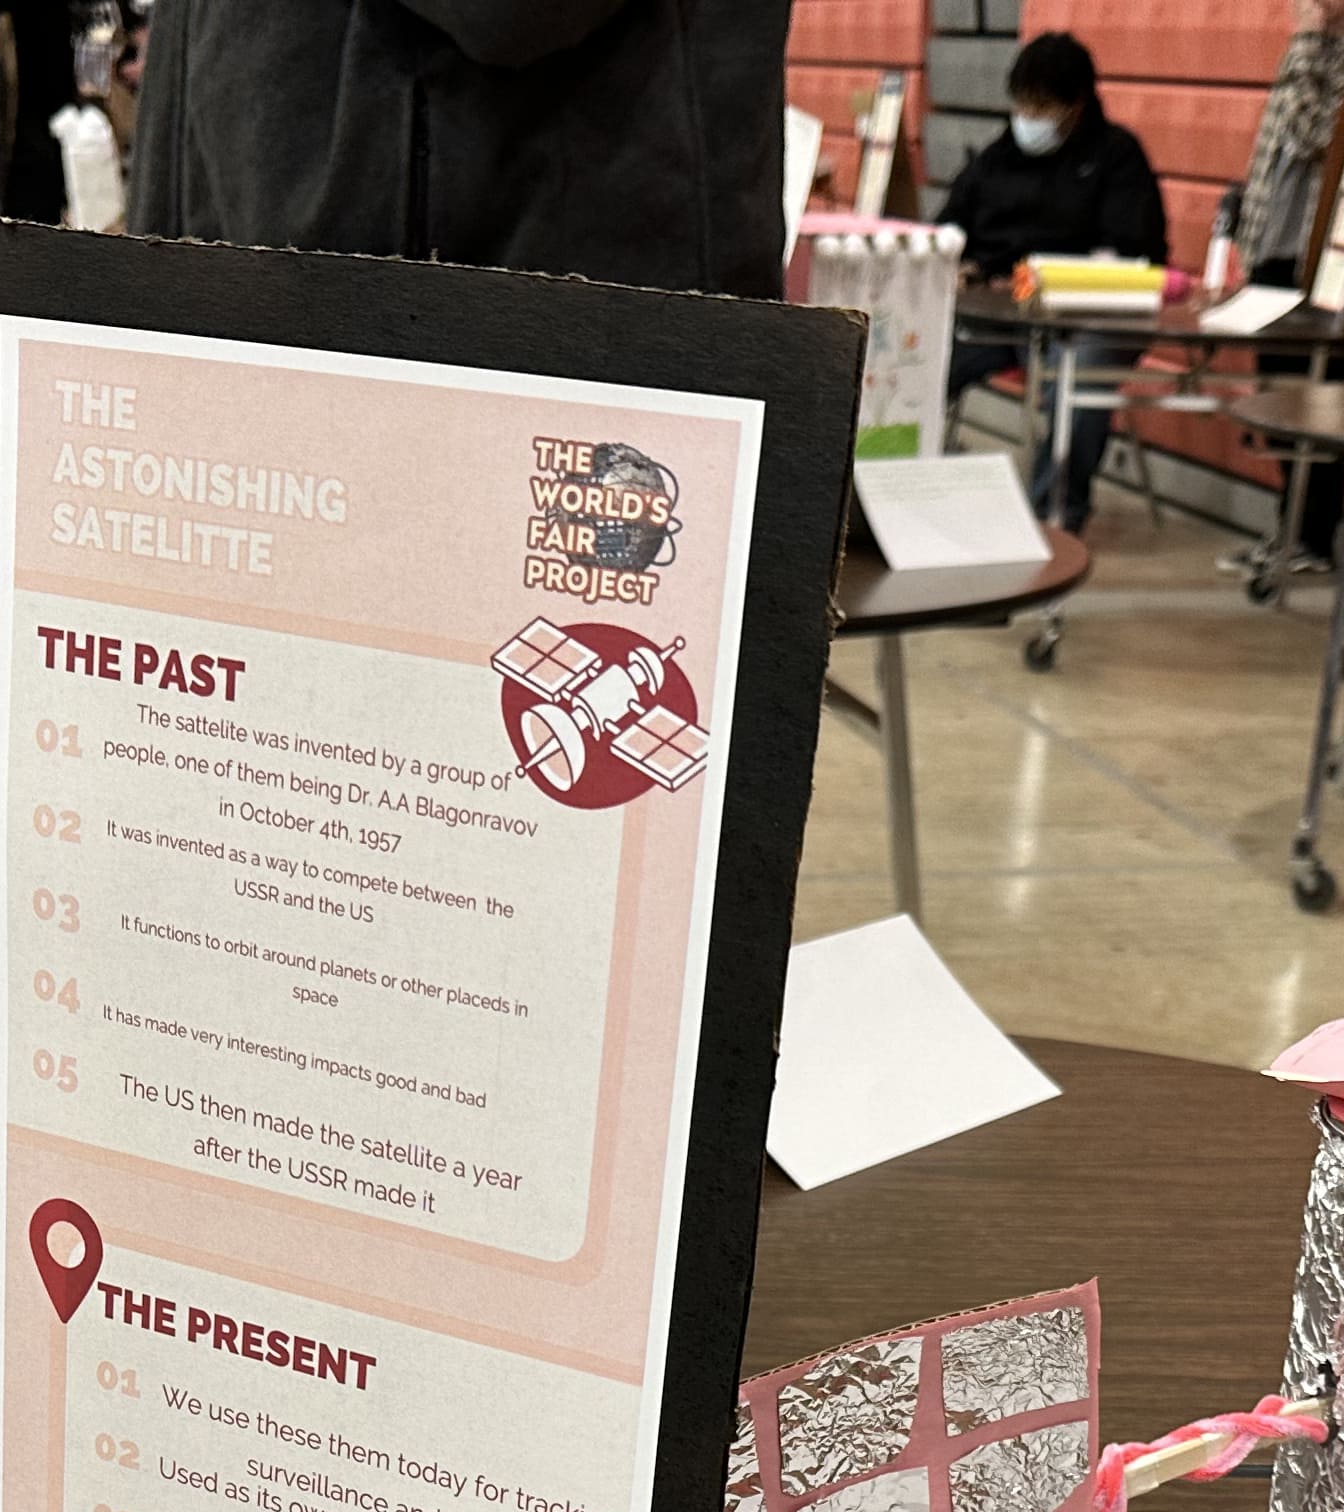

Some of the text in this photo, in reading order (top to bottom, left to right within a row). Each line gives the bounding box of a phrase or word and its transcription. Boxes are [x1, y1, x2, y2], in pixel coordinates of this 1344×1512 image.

[55, 378, 139, 433] THE
[531, 435, 596, 475] THE
[51, 443, 349, 525] ASTONISHING
[527, 478, 673, 525] WORLD'S
[50, 504, 275, 577] SATELITTE
[526, 518, 598, 555] FAIR
[523, 558, 661, 605] PROJECT
[36, 625, 247, 703] THE PAST
[34, 718, 83, 759] 01
[136, 703, 513, 793] The sattelite was invented by a group of
[103, 739, 539, 838] people, one of them being Dr. A.A Blagonravov
[31, 803, 83, 844] 02
[218, 795, 403, 854] in October 4th, 1957
[107, 819, 515, 919] It was invented as a way to compete between the
[31, 887, 82, 933] 03
[234, 877, 374, 924] USSR and the US
[31, 969, 82, 1015] 04
[121, 913, 529, 1018] It functions to orbit around planets or other placeds in
[291, 985, 339, 1008] space
[31, 1049, 80, 1094] 05
[103, 1003, 487, 1109] It has made very interesting impacts good and bad
[119, 1072, 159, 1103] The
[164, 1084, 195, 1112] US
[199, 1093, 247, 1125] then
[252, 1111, 315, 1141] made
[319, 1122, 356, 1151] the
[452, 1160, 466, 1179] a
[472, 1164, 524, 1192] year
[193, 1136, 436, 1214] after the USSR made it
[96, 1280, 378, 1392] THE PRESENT
[94, 1360, 142, 1400] 01
[93, 1432, 142, 1471] 02
[161, 1383, 203, 1416] We
[208, 1402, 250, 1430] use
[256, 1411, 322, 1451] these
[328, 1432, 391, 1472] them
[397, 1452, 468, 1498] today
[474, 1474, 510, 1505] for
[159, 1455, 219, 1495] Used
[224, 1481, 250, 1504] as
[256, 1484, 283, 1512] its
